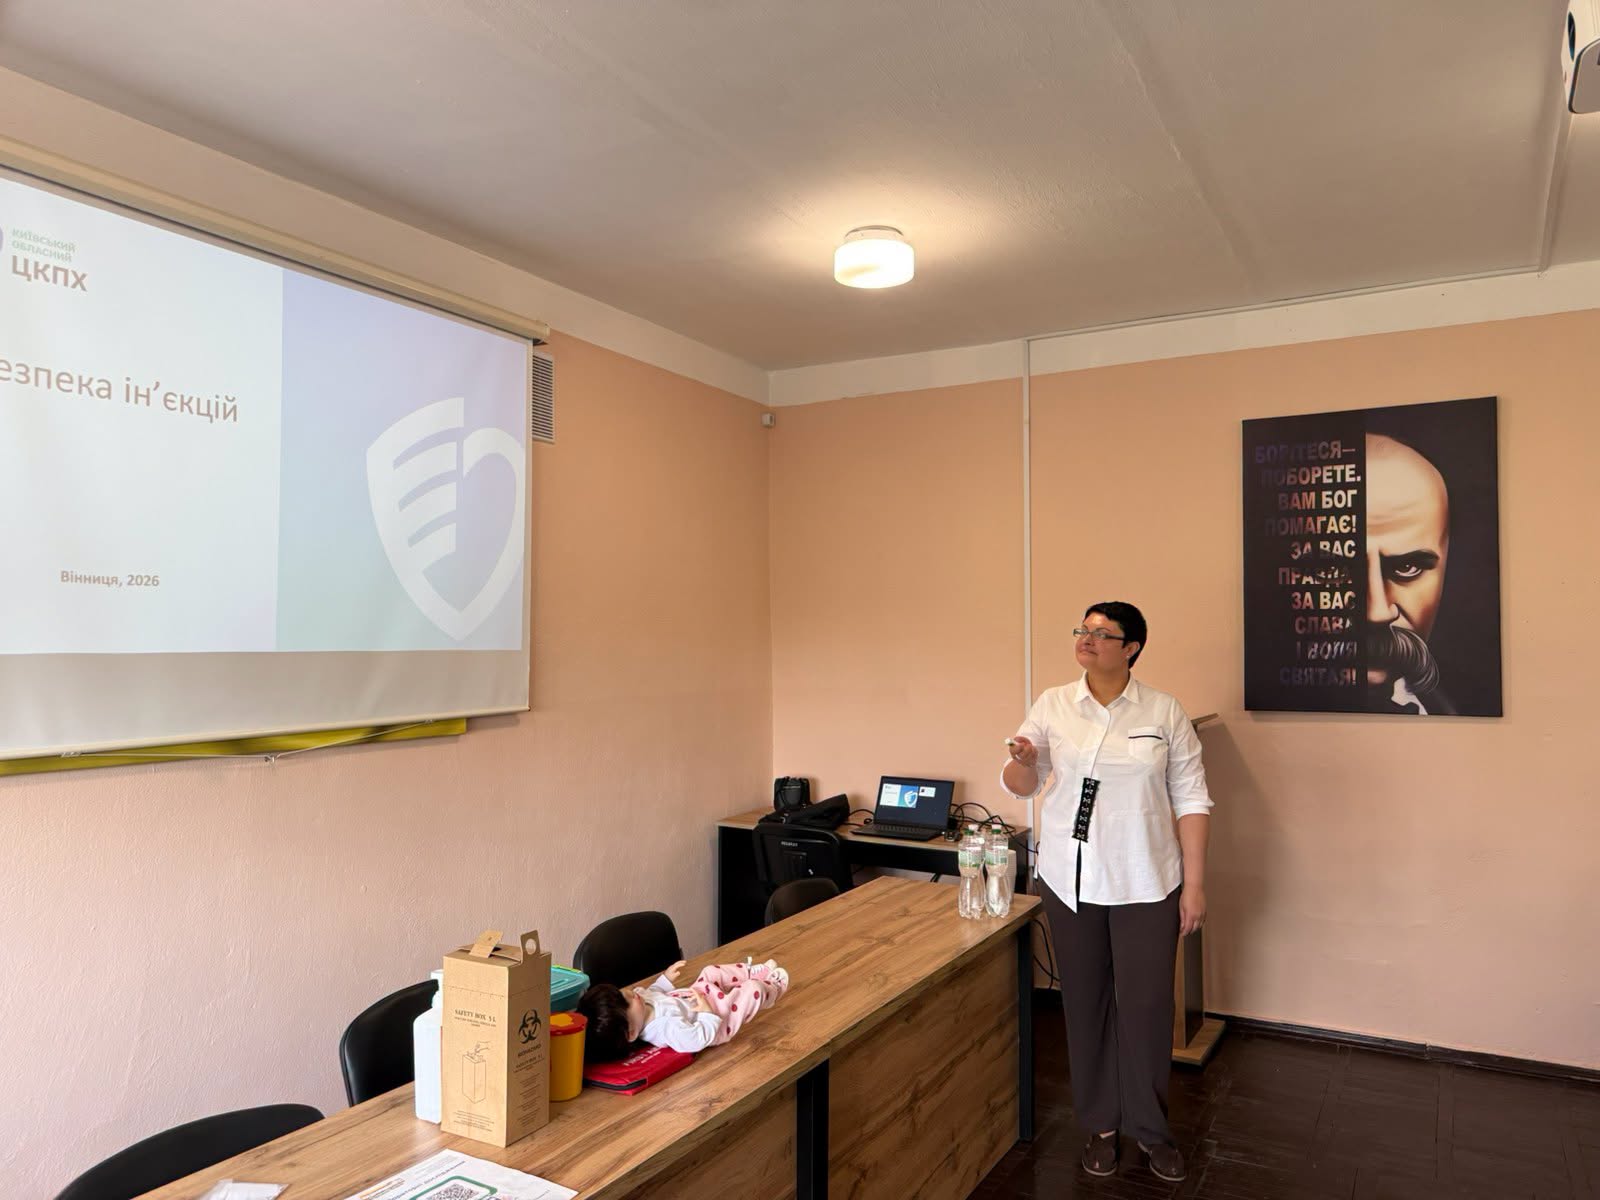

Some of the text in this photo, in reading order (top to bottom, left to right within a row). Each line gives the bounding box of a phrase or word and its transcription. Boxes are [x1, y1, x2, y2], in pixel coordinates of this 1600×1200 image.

[12, 228, 76, 253] КИЇВСЬКИЙ
[12, 240, 72, 263] ОБЛАСНИЙ
[12, 255, 88, 292] ЦКПХ
[1278, 490, 1357, 511] ВАМ БОГ
[1265, 515, 1357, 536] ПОМАГАЄ!
[1291, 540, 1357, 560] ЗА ВАС
[60, 570, 160, 588] Вінниця, 2026
[1292, 591, 1357, 610] ЗА ВАС
